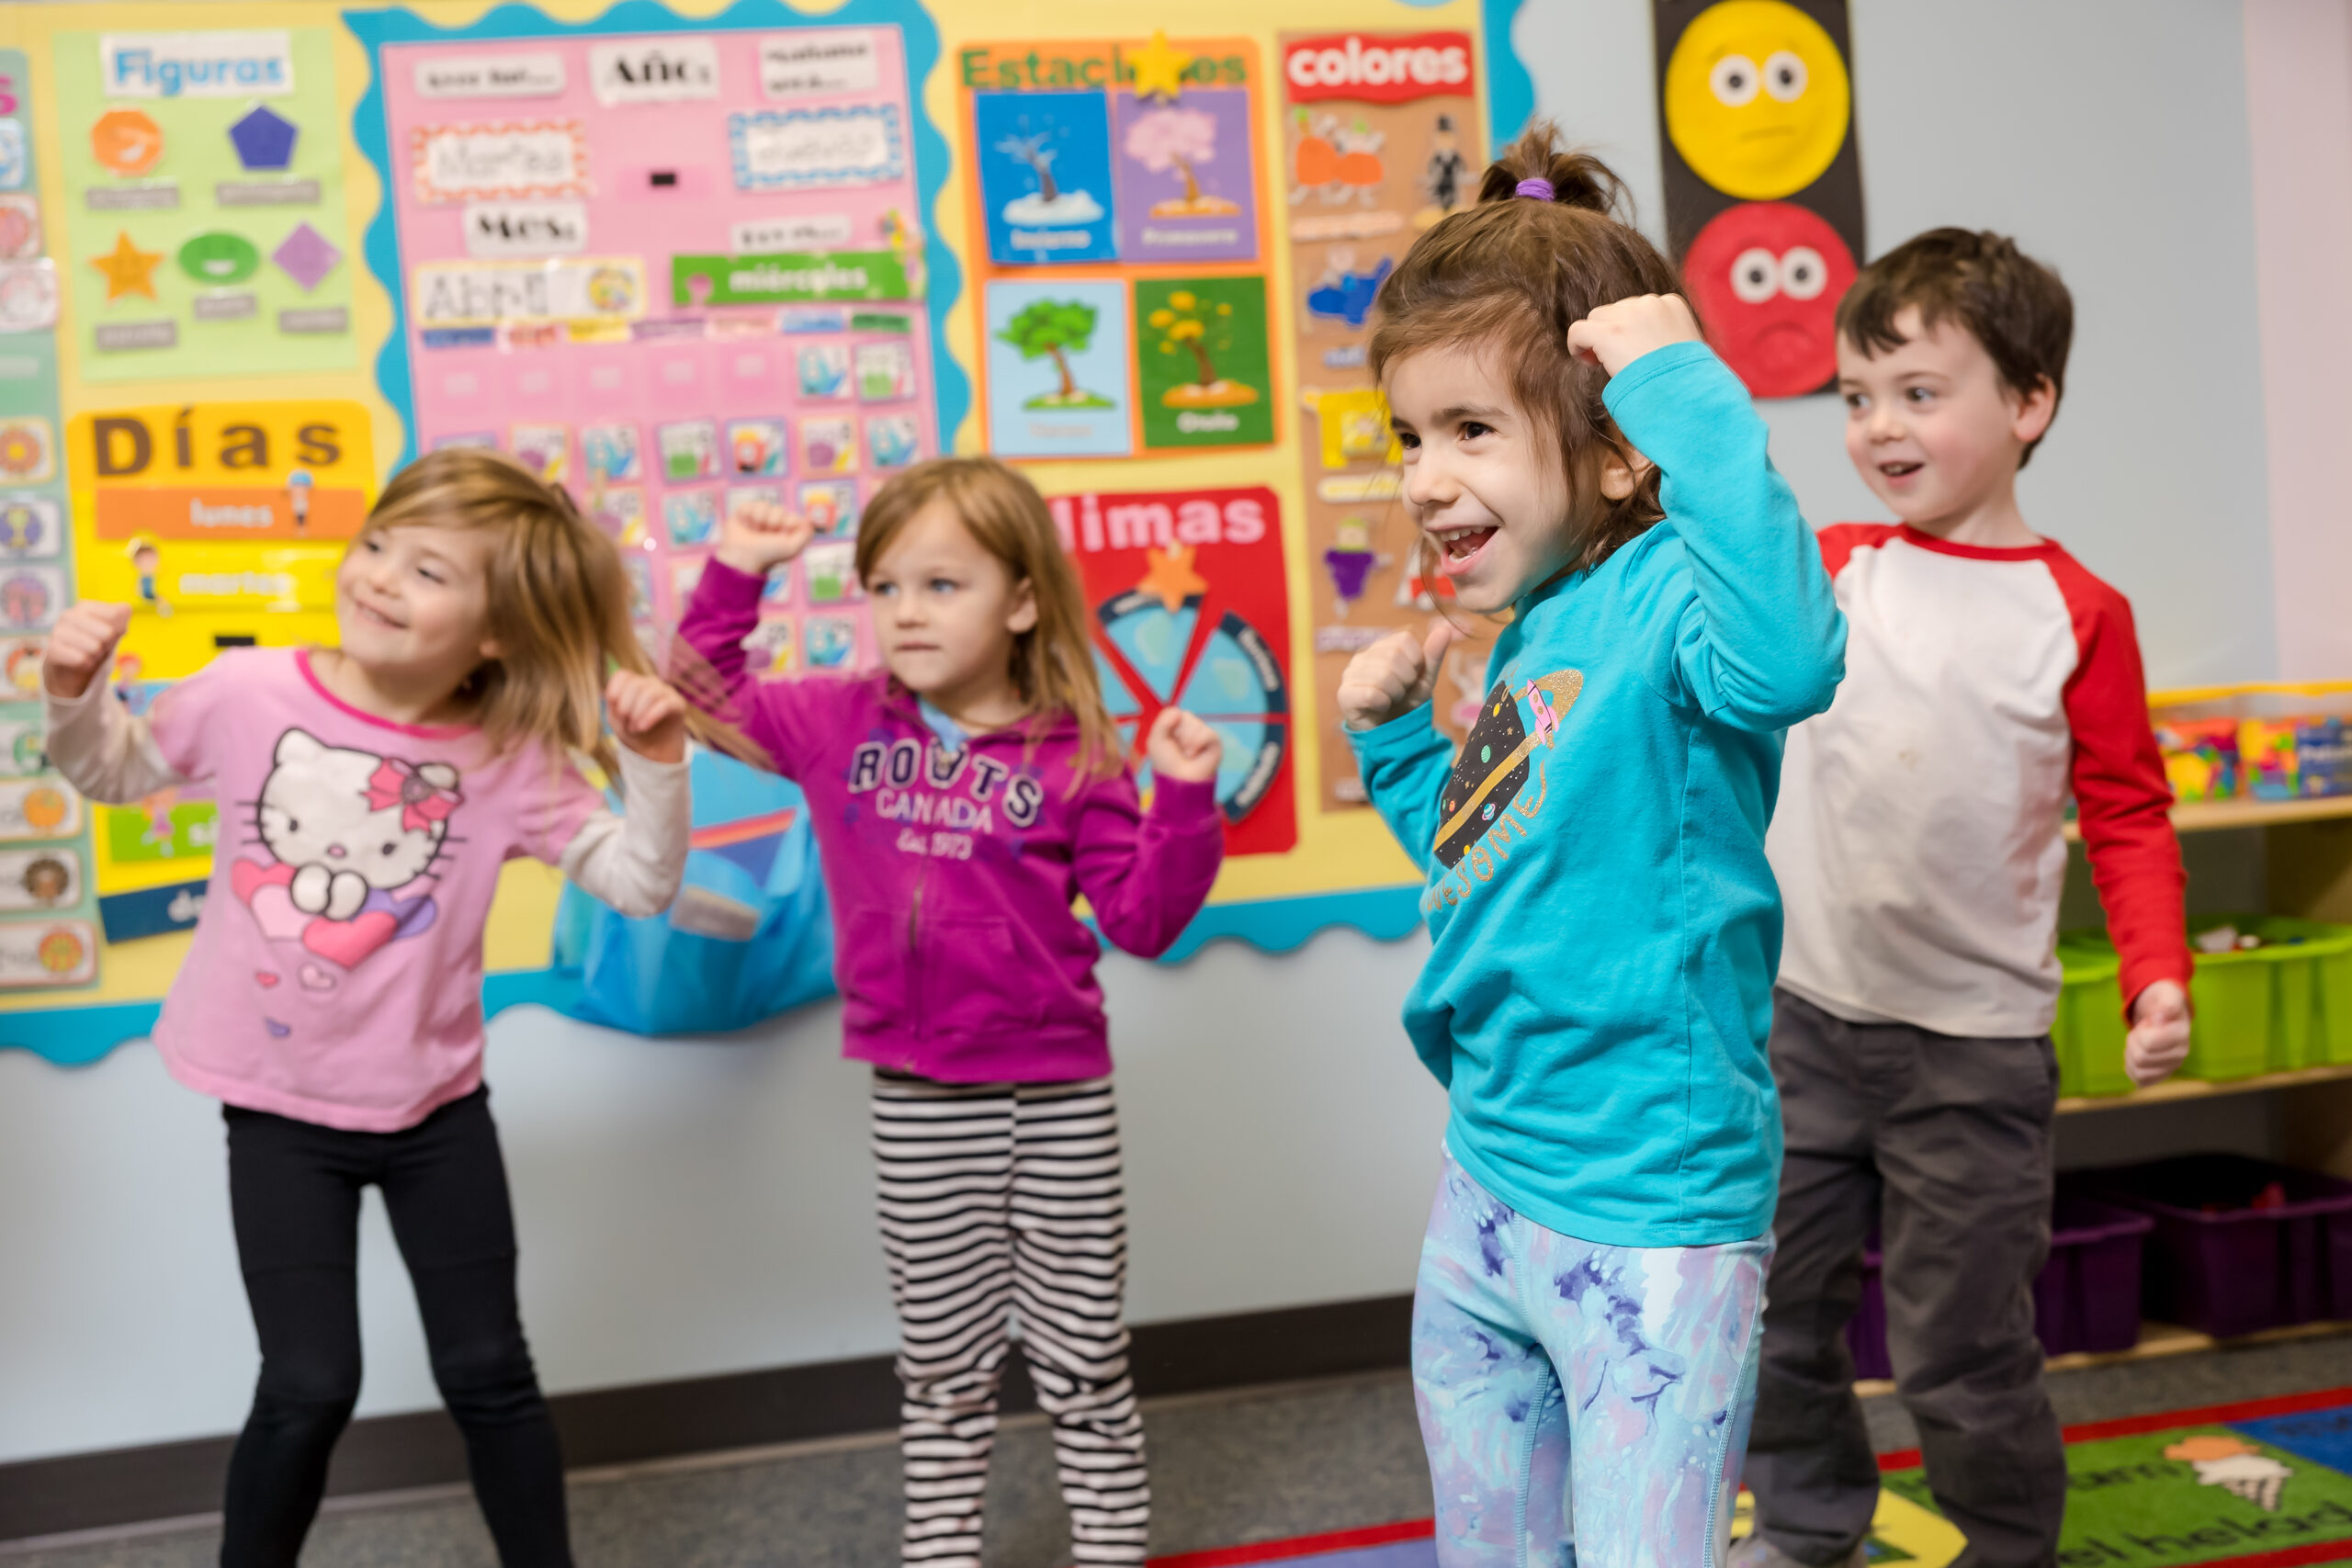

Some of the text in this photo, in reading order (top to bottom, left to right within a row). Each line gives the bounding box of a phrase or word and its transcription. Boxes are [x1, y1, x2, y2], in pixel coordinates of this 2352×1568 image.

[114, 49, 285, 96] Figuras
[962, 44, 1246, 87] Estacies
[1288, 36, 1467, 86] colores
[94, 406, 343, 477] Días
[1050, 491, 1267, 553] limas
[848, 738, 1044, 828] ROOTS
[876, 787, 993, 835] CANADA
[1427, 760, 1548, 912] WESOME
[2120, 1500, 2352, 1557] helad
